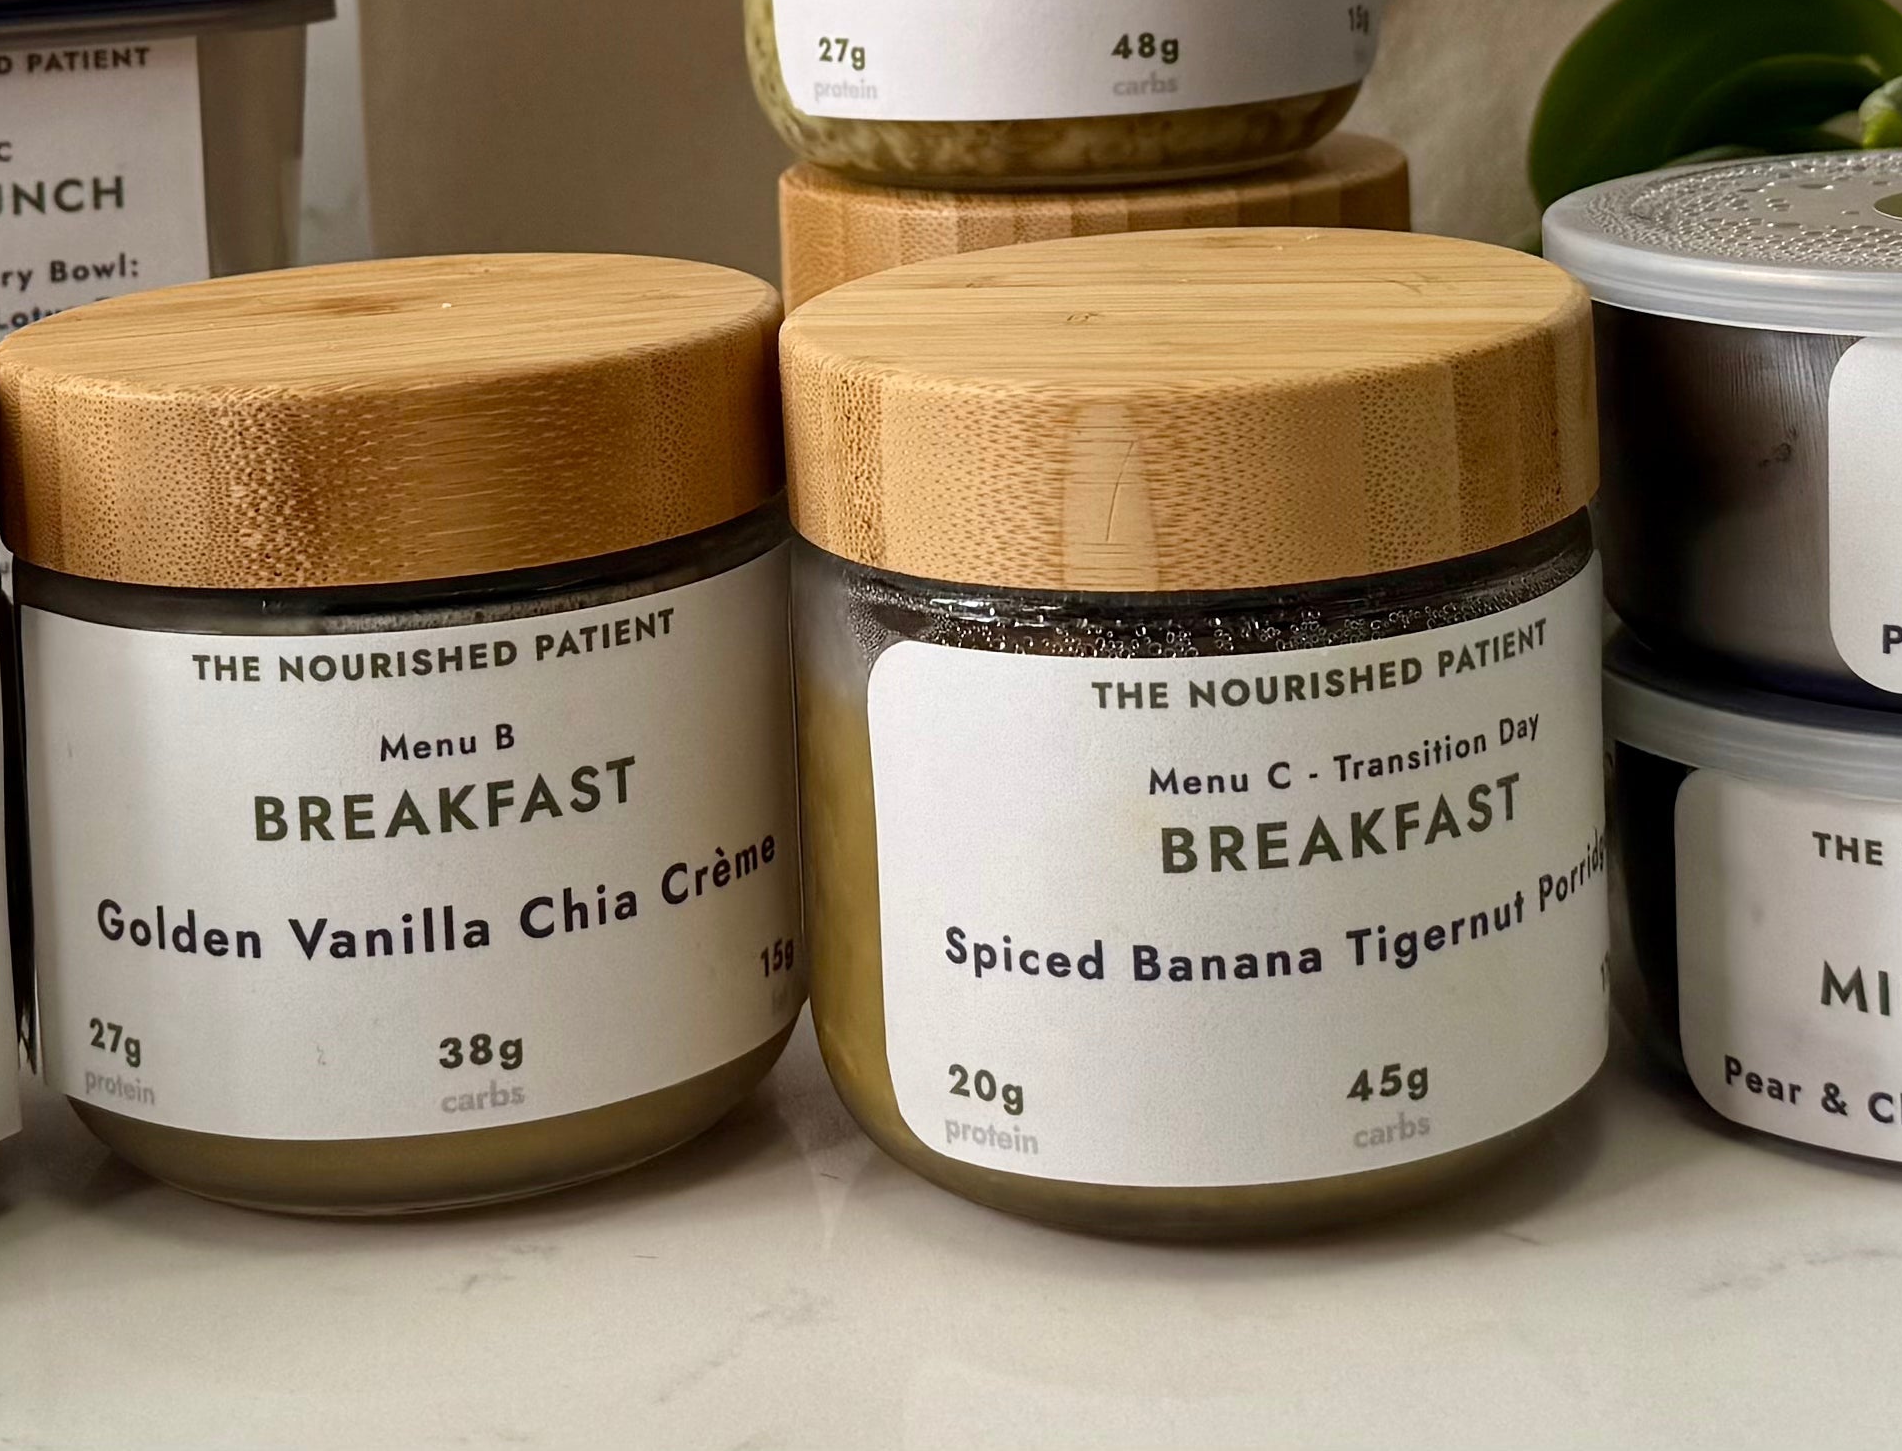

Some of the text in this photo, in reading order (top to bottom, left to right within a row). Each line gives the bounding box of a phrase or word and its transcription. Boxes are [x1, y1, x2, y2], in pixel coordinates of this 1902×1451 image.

[819, 37, 865, 71] 27g
[1112, 33, 1178, 64] 48g
[814, 77, 878, 102] protein
[1112, 71, 1178, 96] carbs
[50, 253, 138, 283] Bowl:
[1092, 617, 1547, 709] THE NOURISHED PATIENT
[1150, 714, 1538, 795] Menu C Transition Day
[1163, 773, 1520, 875] BREAKFAST
[98, 835, 774, 960] Golden Vanilla Chia Crème
[946, 926, 1104, 980] Spiced
[1133, 945, 1321, 982] Banana
[1346, 891, 1524, 969] Tigernut
[761, 939, 794, 977] 15g
[90, 1018, 140, 1068] 27g
[439, 1034, 522, 1070] 38g
[84, 1070, 155, 1106] protein
[441, 1083, 525, 1114] carbs
[949, 1064, 1023, 1115] 20g
[1347, 1063, 1428, 1102] 45g
[1725, 1055, 1801, 1105] Pear
[1822, 1083, 1847, 1116] &
[945, 1117, 1039, 1155] protein
[1353, 1113, 1431, 1149] carbs
